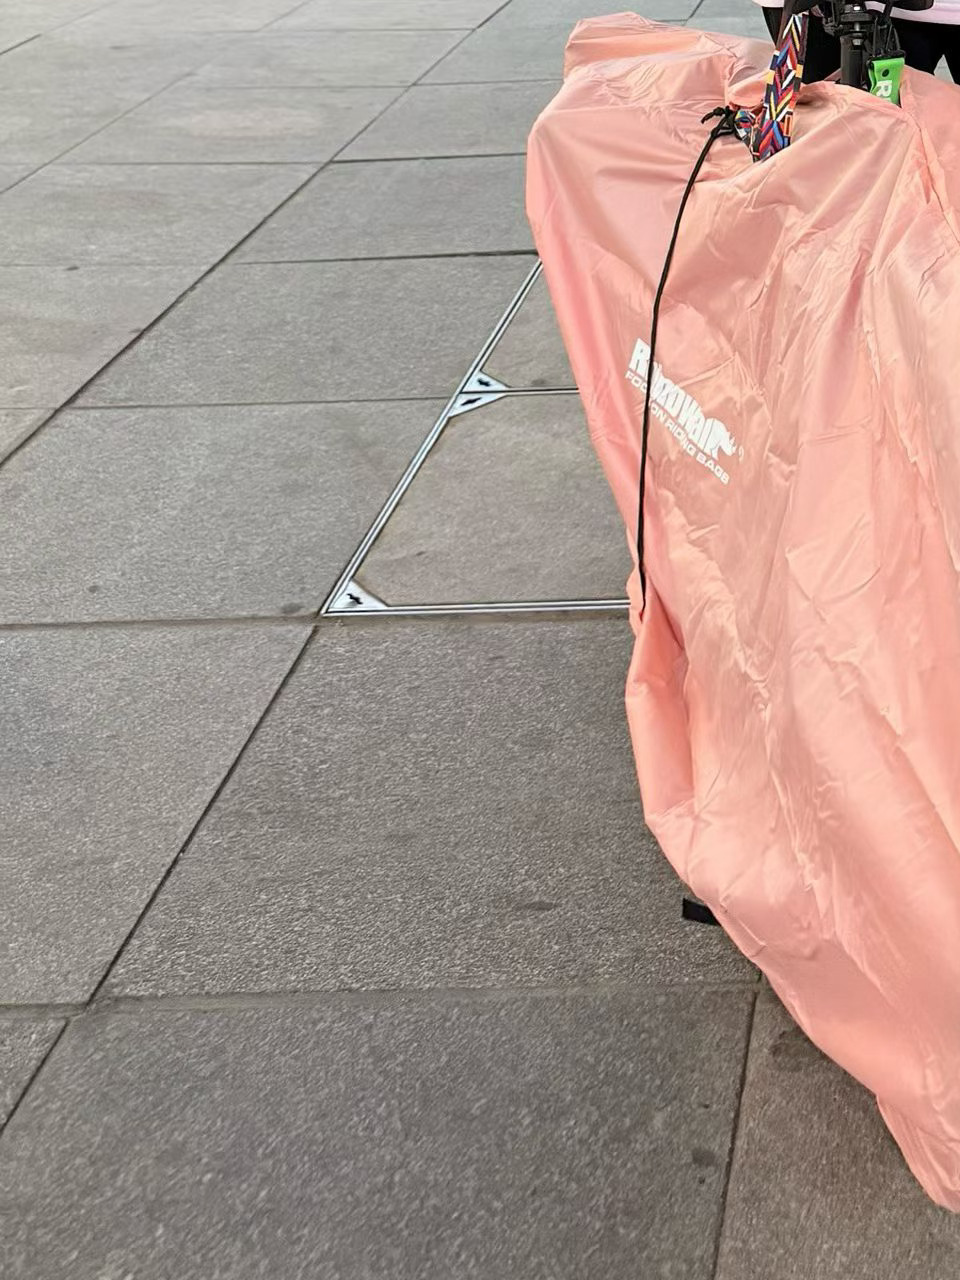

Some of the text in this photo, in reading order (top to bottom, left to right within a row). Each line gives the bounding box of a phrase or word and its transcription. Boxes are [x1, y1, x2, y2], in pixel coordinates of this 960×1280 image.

[649, 402, 667, 423] ON
[666, 418, 697, 458] RIDING
[696, 451, 731, 485] BAGS
